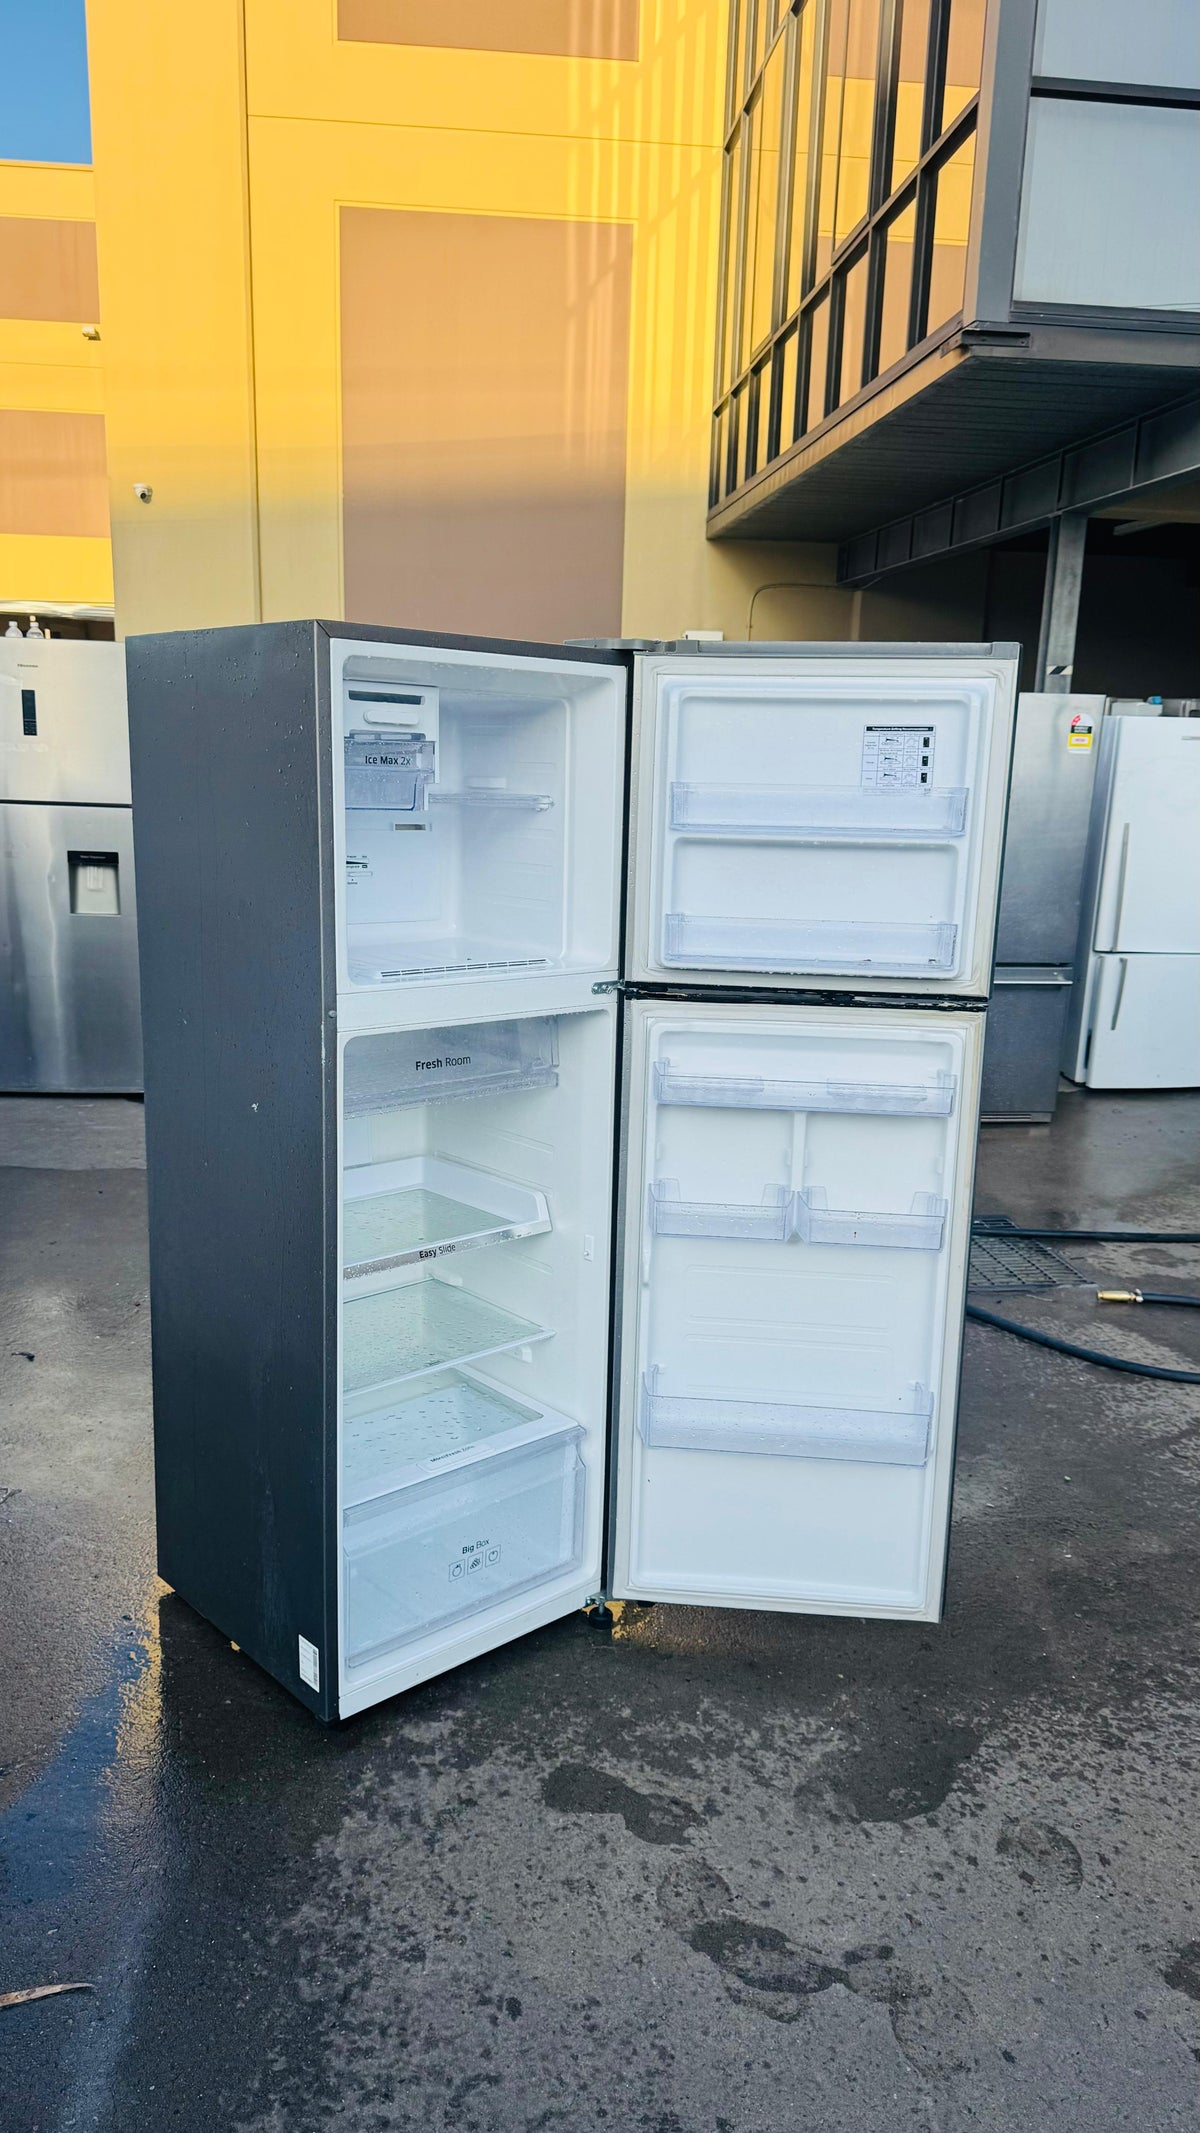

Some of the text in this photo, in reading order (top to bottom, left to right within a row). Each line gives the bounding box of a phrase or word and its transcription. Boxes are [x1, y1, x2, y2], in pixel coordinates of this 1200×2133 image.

[365, 755, 411, 766] Ice Max 2x
[415, 1056, 471, 1071] Fresh Room
[419, 1243, 456, 1259] Easy Slide
[462, 1539, 490, 1555] Big Box
